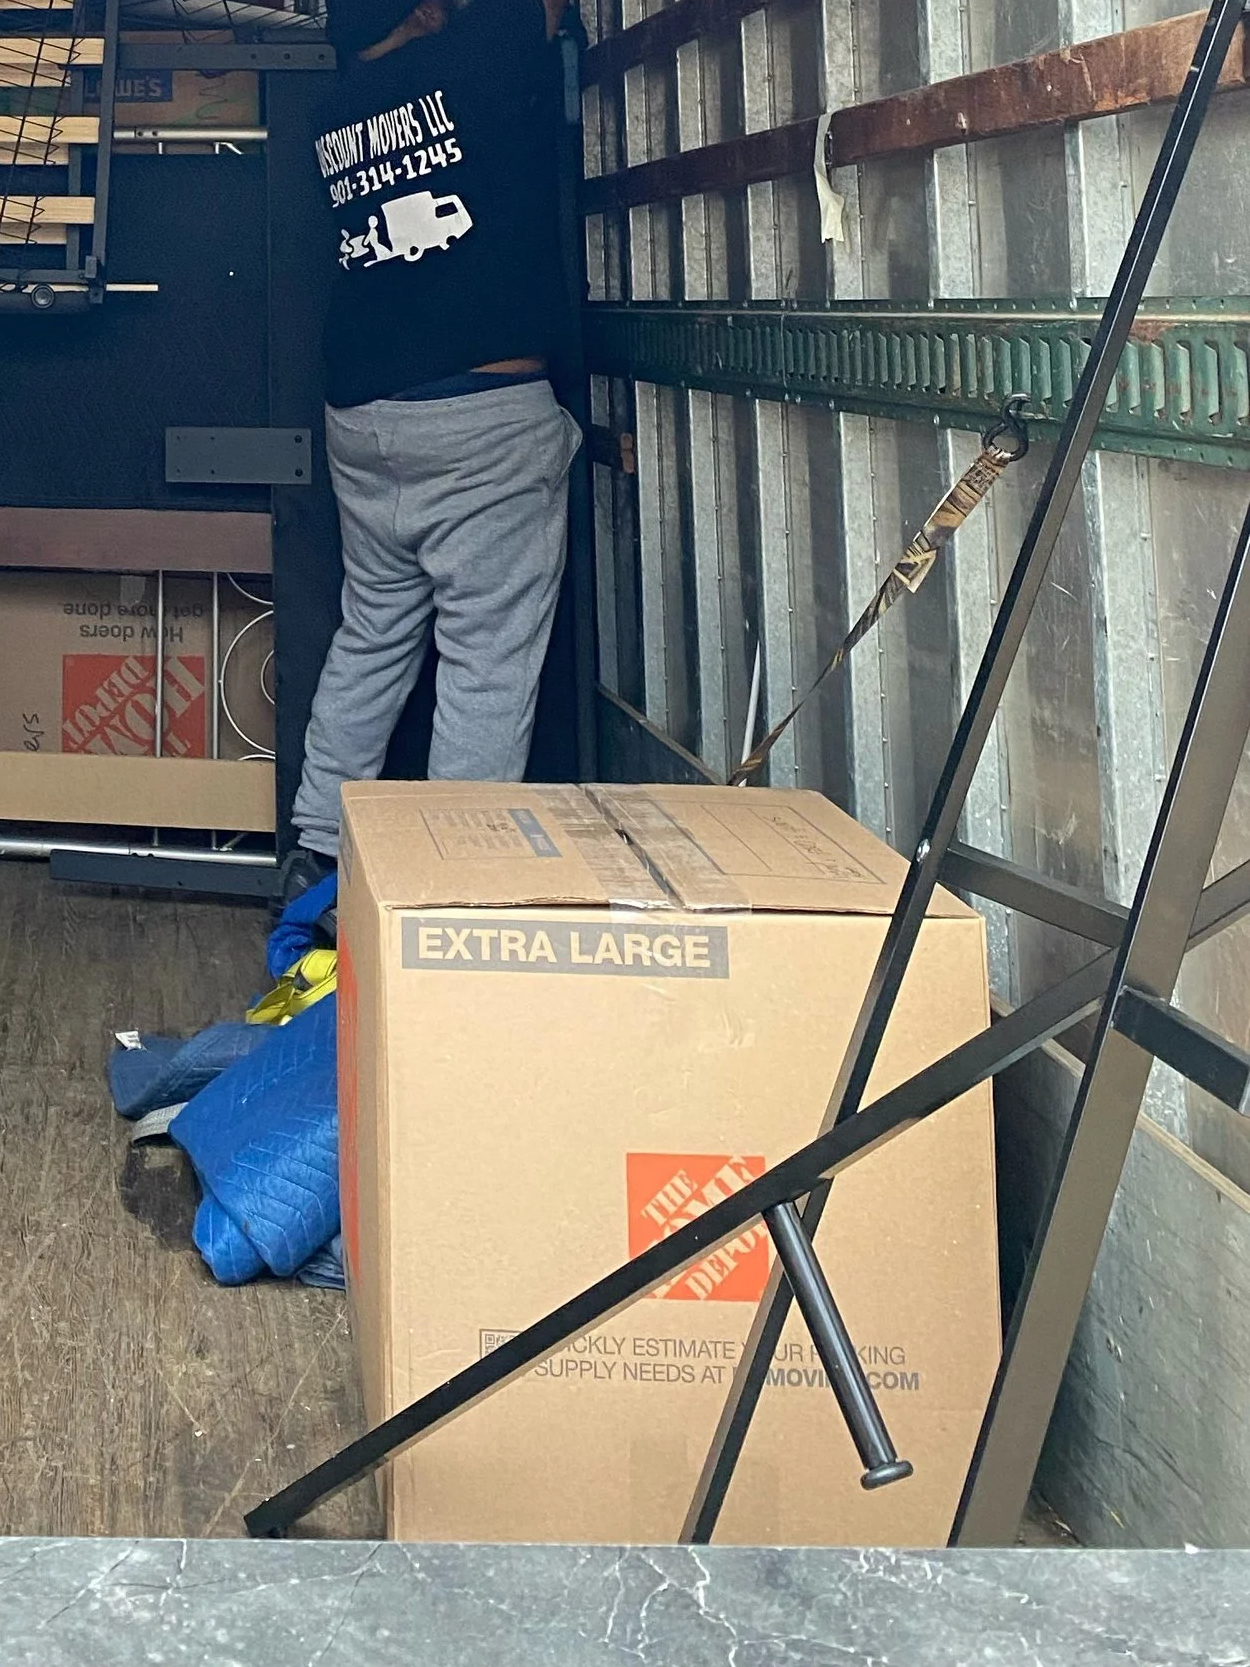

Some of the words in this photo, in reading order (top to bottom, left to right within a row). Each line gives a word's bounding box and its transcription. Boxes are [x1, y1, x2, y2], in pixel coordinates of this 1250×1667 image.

[85, 76, 162, 97] LWE'S
[367, 102, 424, 160] MOVERS
[418, 90, 455, 138] LLC
[330, 137, 463, 208] 901-314-1245
[62, 602, 112, 620] done
[174, 603, 204, 619] get
[79, 624, 135, 642] doers
[417, 926, 557, 963] EXTRA
[570, 931, 711, 968] LARGE
[640, 1169, 699, 1226] THE
[565, 1336, 626, 1356] CKLY
[633, 1337, 736, 1360] ESTIMATE
[742, 1342, 804, 1363] UR
[810, 1345, 906, 1366] PKING
[534, 1359, 617, 1380] SUPPLY
[623, 1362, 696, 1384] NEEDS
[701, 1366, 727, 1384] AT
